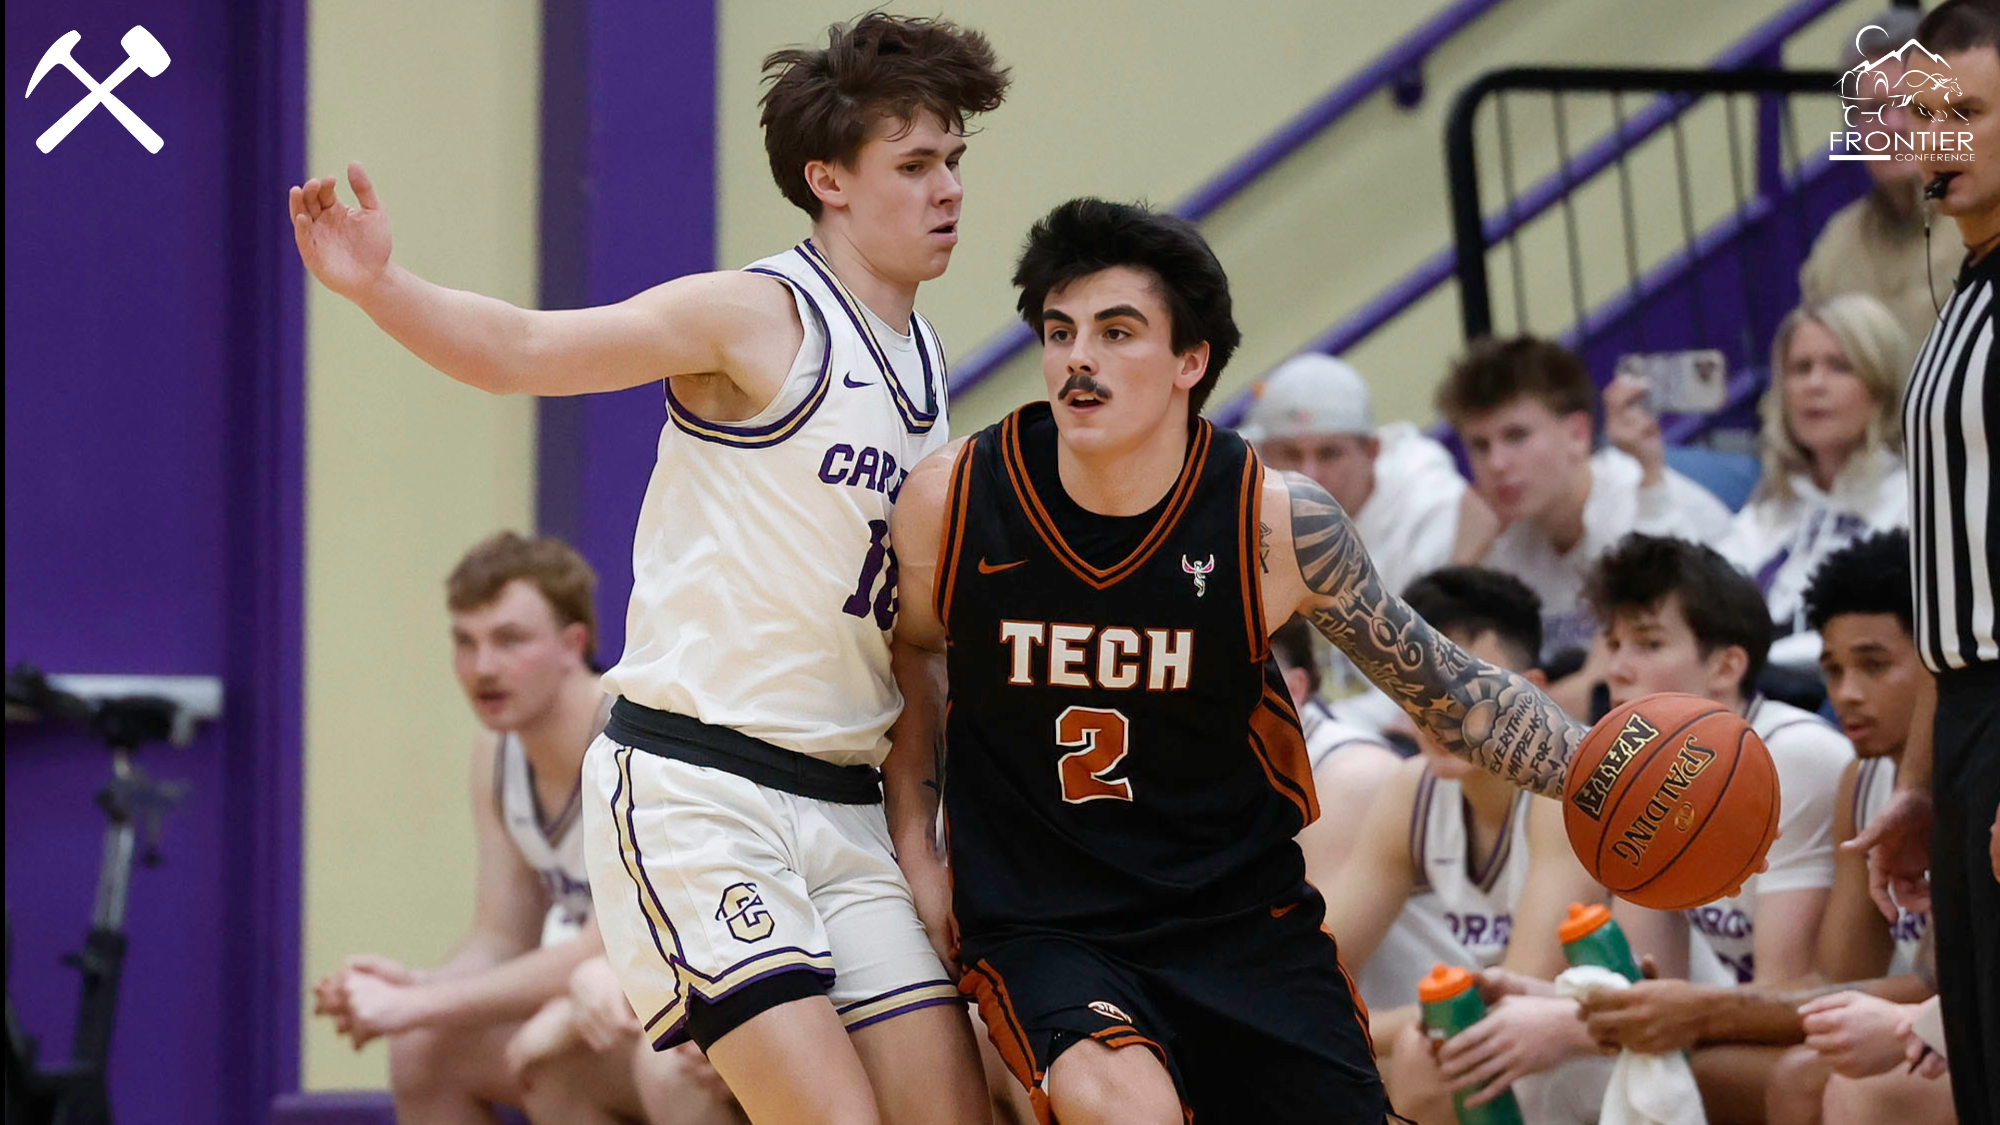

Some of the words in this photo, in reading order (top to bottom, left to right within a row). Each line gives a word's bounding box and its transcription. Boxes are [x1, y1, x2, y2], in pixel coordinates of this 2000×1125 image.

[1000, 619, 1194, 692] TECH
[1055, 705, 1133, 804] 2
[1489, 694, 1533, 775] EVERYTHING
[1529, 740, 1553, 775] FOR
[1573, 713, 1660, 818] NAIA
[1611, 735, 1716, 867] SPALDING
